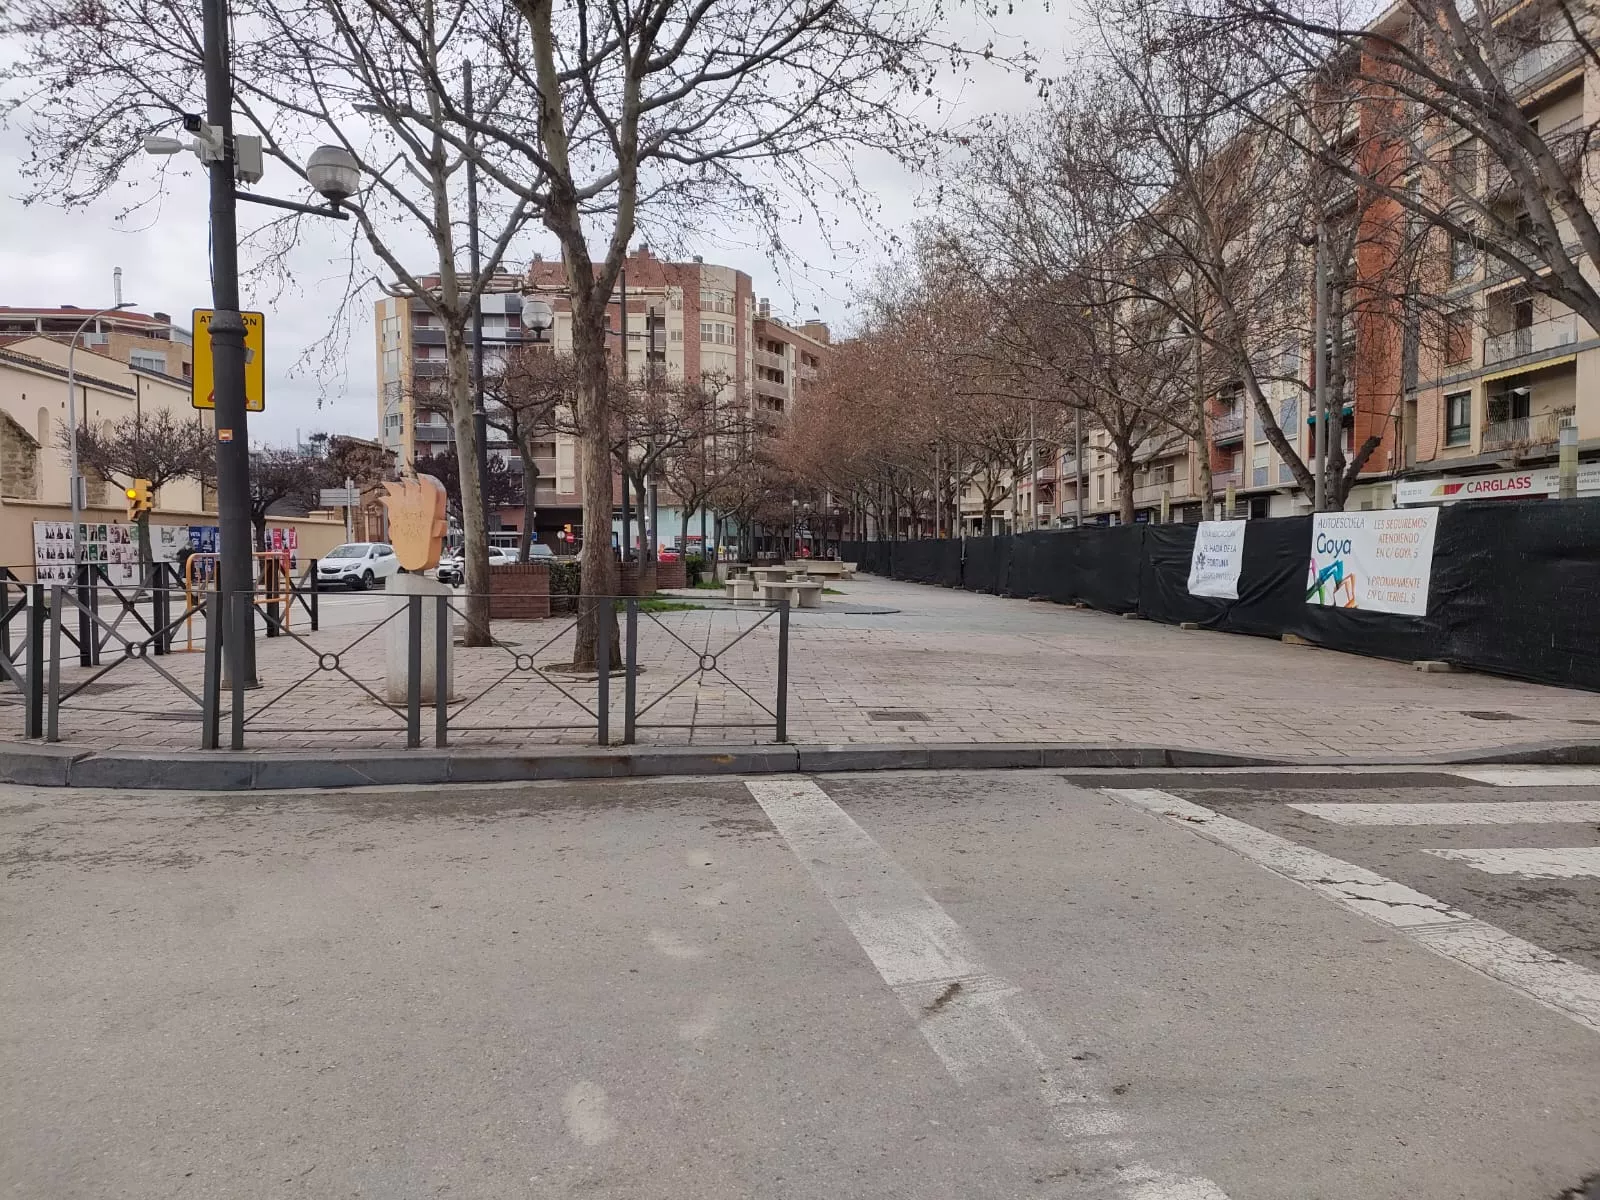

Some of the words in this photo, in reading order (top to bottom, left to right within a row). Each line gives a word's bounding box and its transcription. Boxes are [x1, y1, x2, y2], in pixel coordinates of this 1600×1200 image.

[199, 315, 257, 326] ATÓN
[1466, 477, 1532, 493] CARGLASS
[1318, 518, 1365, 529] AUTOESCUELA
[1374, 520, 1385, 530] LES
[1386, 518, 1428, 529] SEGUIREMOS
[1378, 532, 1420, 545] ATENDIENDO
[1316, 533, 1352, 558] Goya
[1376, 548, 1385, 558] EN
